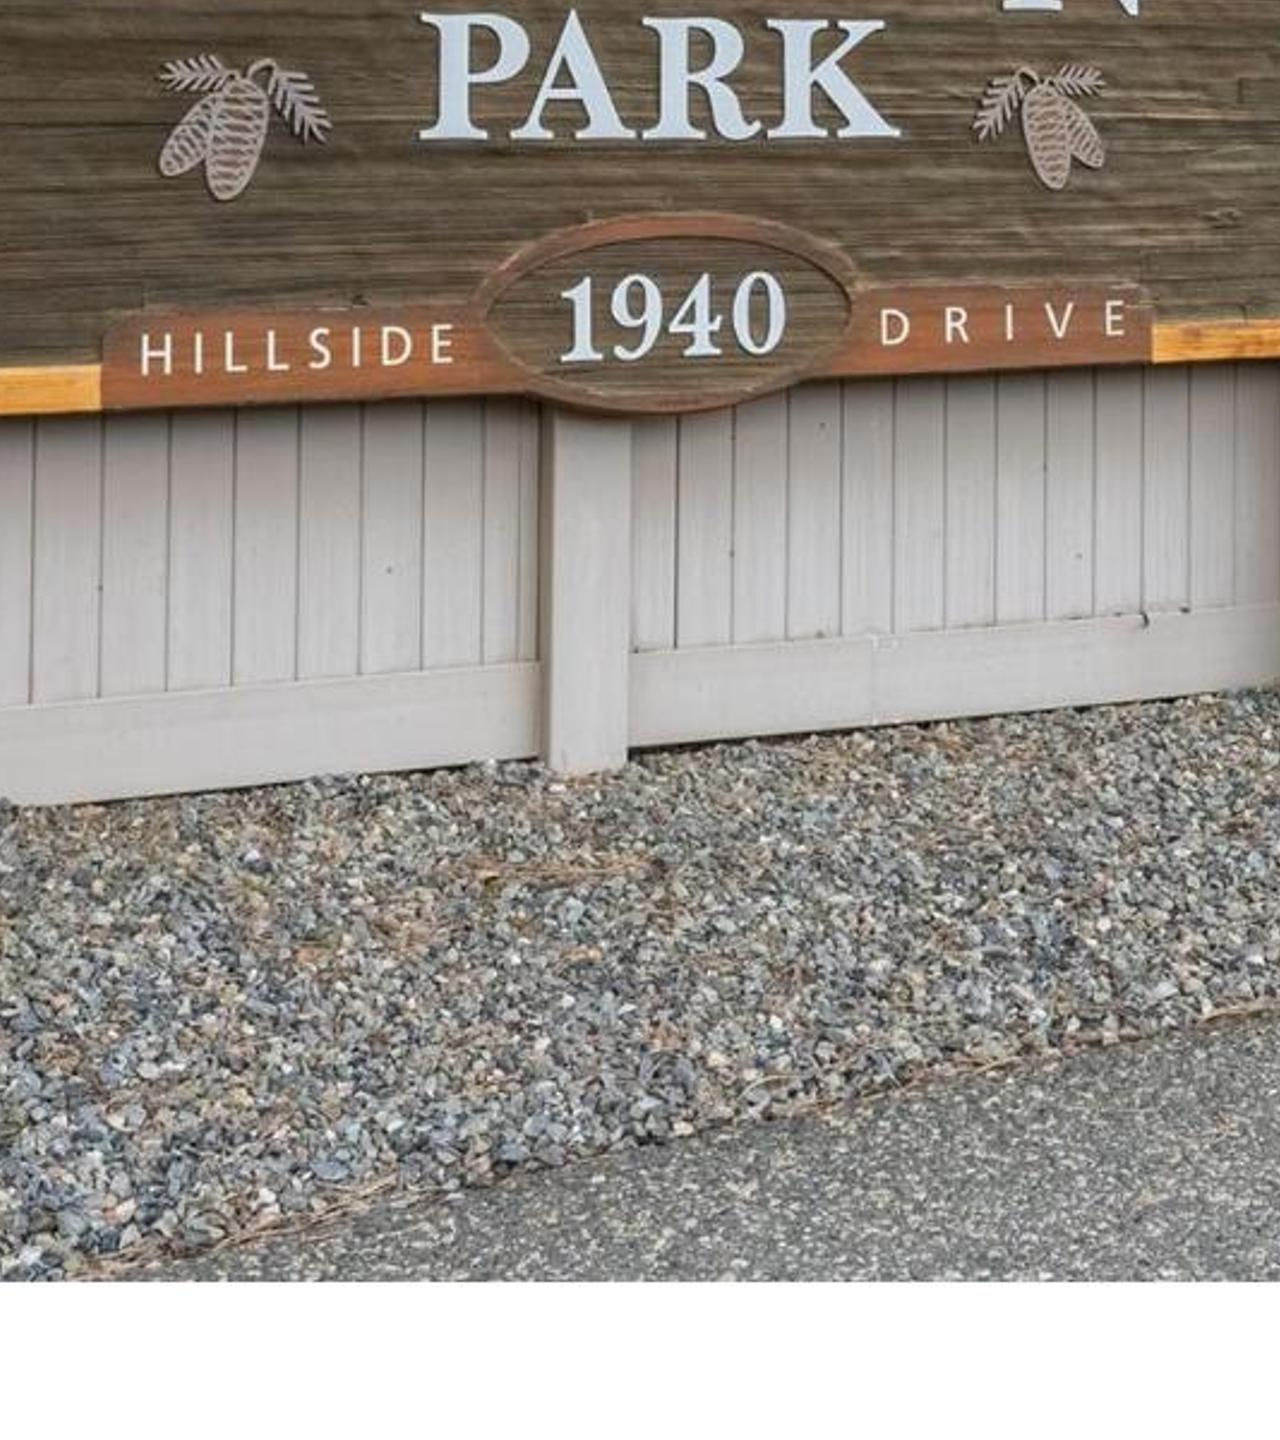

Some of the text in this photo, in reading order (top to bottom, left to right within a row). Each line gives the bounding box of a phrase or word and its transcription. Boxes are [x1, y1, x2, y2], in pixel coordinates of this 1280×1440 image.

[418, 9, 902, 142] PARK
[140, 269, 1128, 377] HILLSIDE 1940 DRIVE
